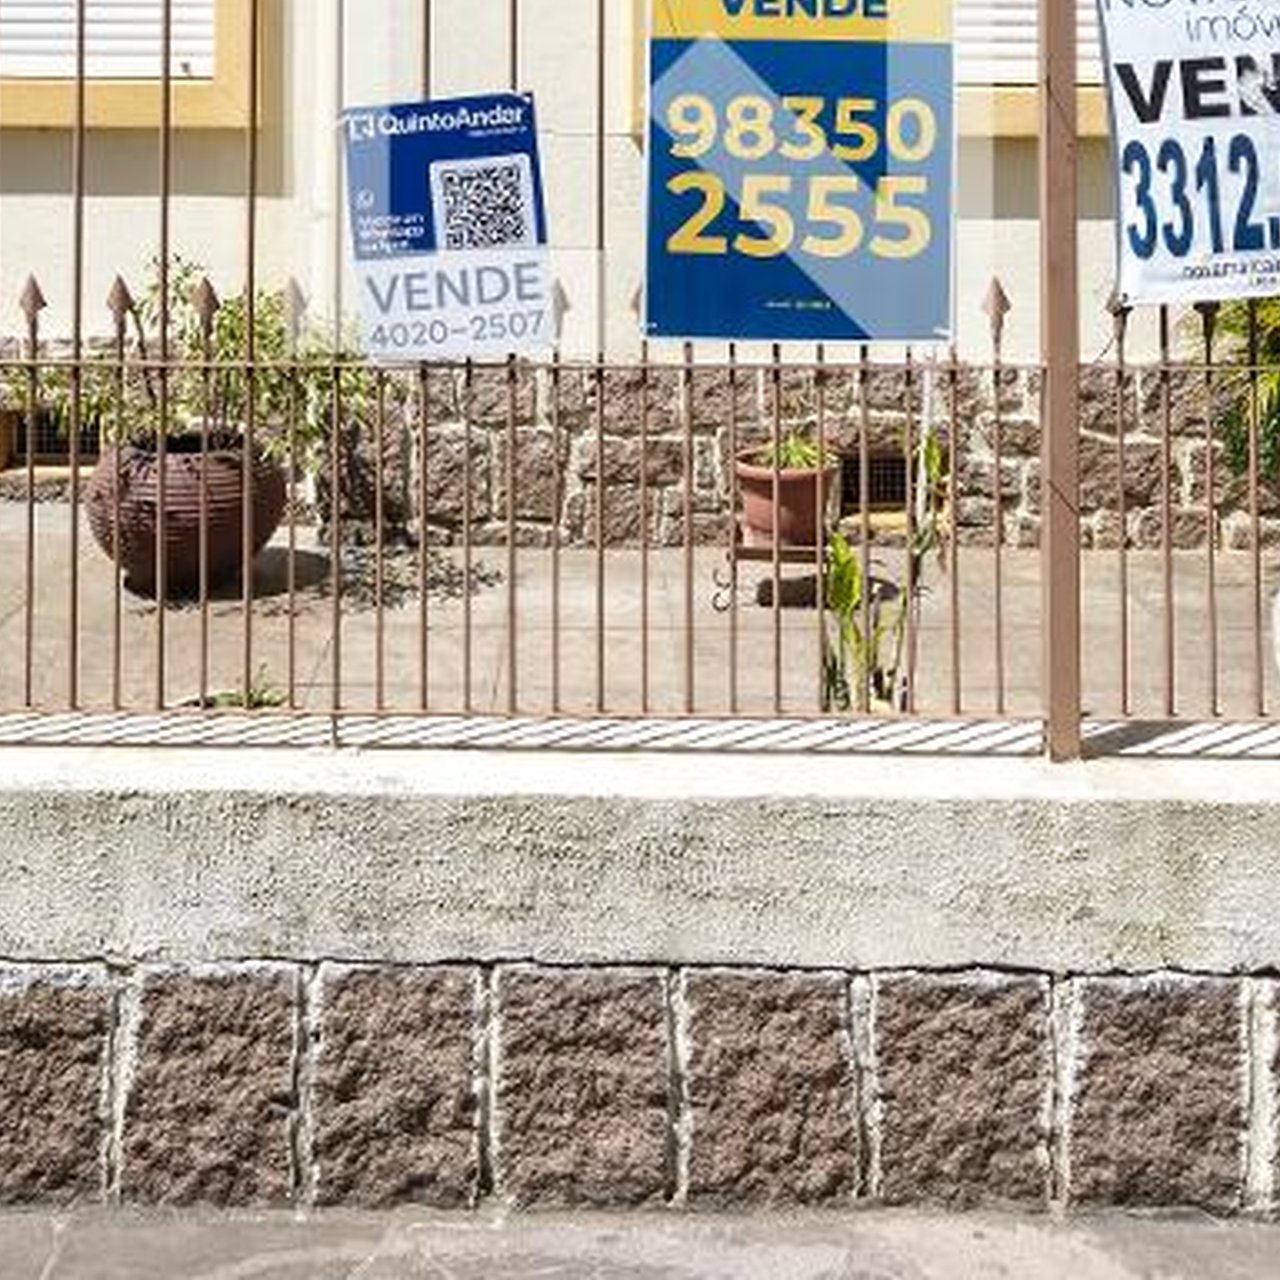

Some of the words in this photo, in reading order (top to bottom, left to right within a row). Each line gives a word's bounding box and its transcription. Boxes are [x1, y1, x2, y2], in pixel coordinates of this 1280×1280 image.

[378, 104, 523, 135] QuintoAndar
[666, 93, 936, 162] 98350
[666, 171, 931, 259] 2555
[366, 262, 544, 315] VENDE
[372, 310, 545, 349] 4020-2507
